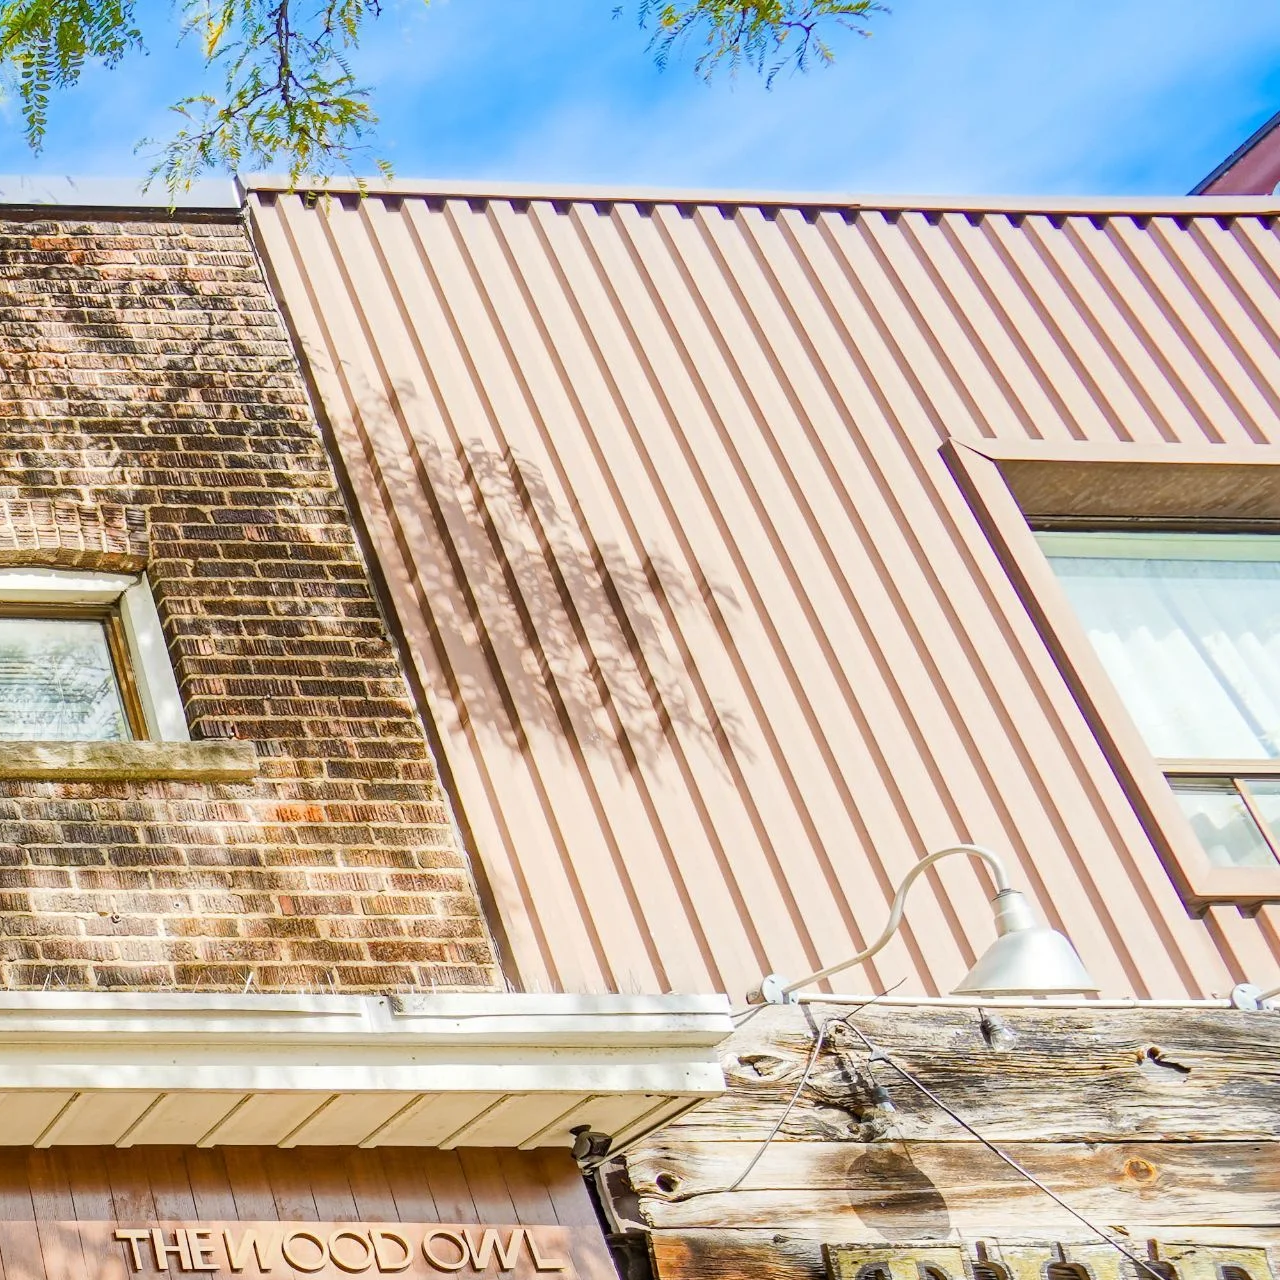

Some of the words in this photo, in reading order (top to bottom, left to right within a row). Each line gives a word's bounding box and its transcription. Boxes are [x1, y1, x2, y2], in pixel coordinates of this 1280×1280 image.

[114, 1227, 221, 1272] THE
[222, 1227, 414, 1273] WOOD
[420, 1228, 569, 1272] OWL
